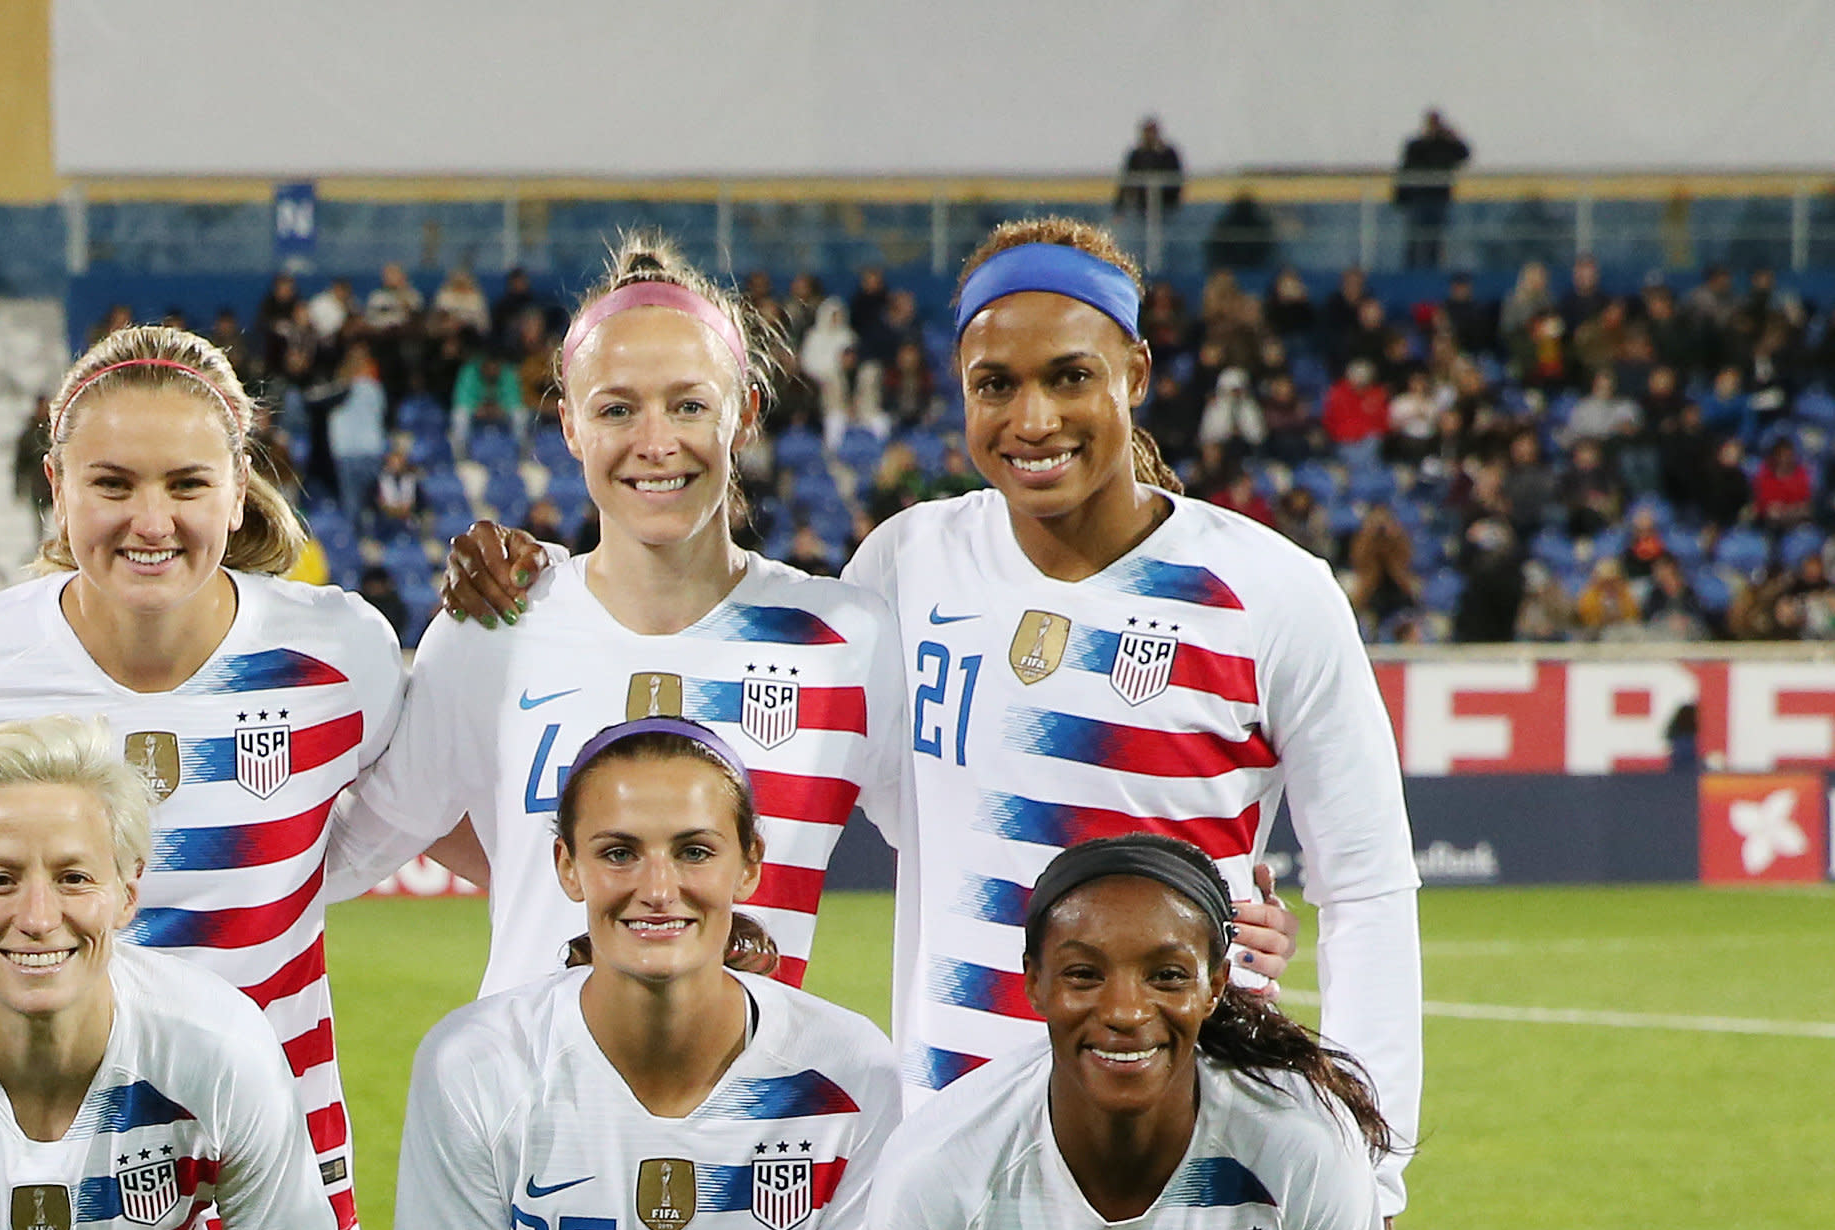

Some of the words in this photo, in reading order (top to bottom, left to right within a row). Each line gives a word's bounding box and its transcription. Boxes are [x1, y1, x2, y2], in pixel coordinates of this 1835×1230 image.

[276, 199, 314, 238] N
[1020, 656, 1046, 669] FIFA
[1123, 637, 1171, 665] USA
[747, 683, 794, 709] USA
[914, 640, 983, 767] 21
[241, 731, 285, 757] USA
[123, 1168, 172, 1193] USA
[757, 1163, 808, 1191] USA
[651, 1208, 681, 1219] FIFA
